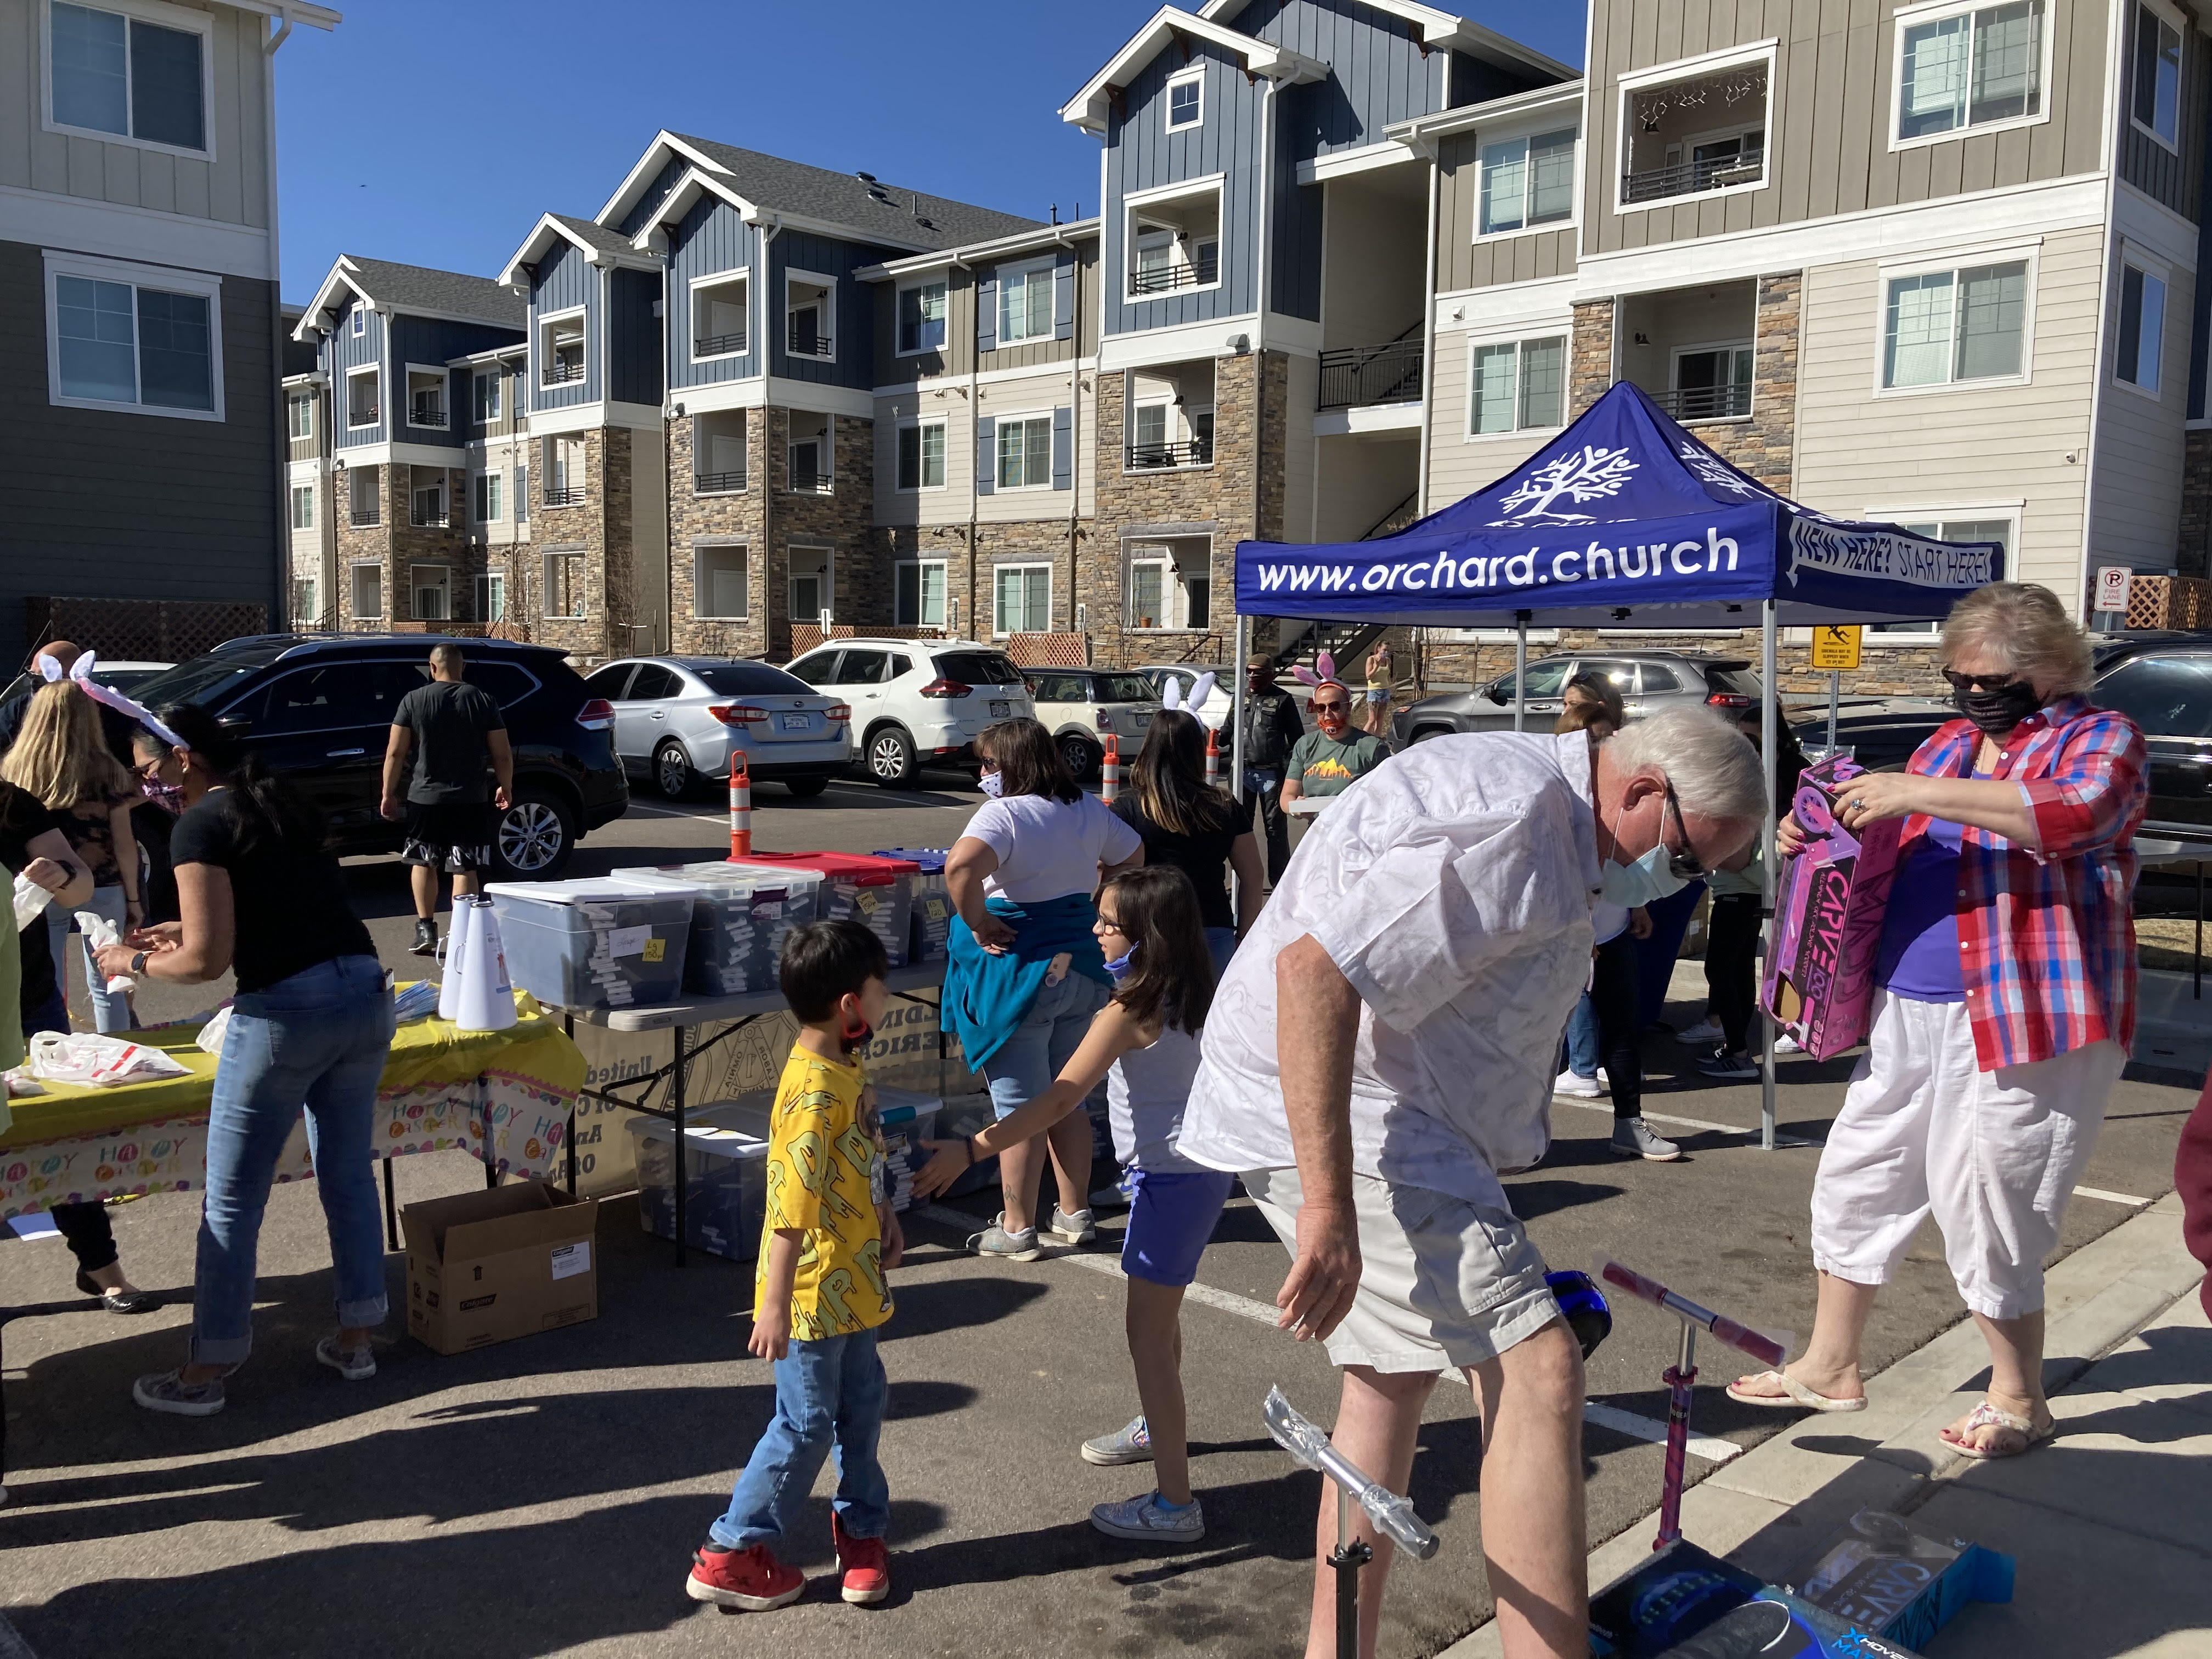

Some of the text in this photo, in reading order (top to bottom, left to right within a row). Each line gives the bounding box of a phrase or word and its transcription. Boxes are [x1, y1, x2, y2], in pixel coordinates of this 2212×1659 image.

[1258, 527, 1738, 592] www.orchard.church
[1795, 522, 1989, 584] NEW HERE? START HERE!
[1810, 871, 1848, 974] CARVE
[461, 1296, 493, 1309] Colgate
